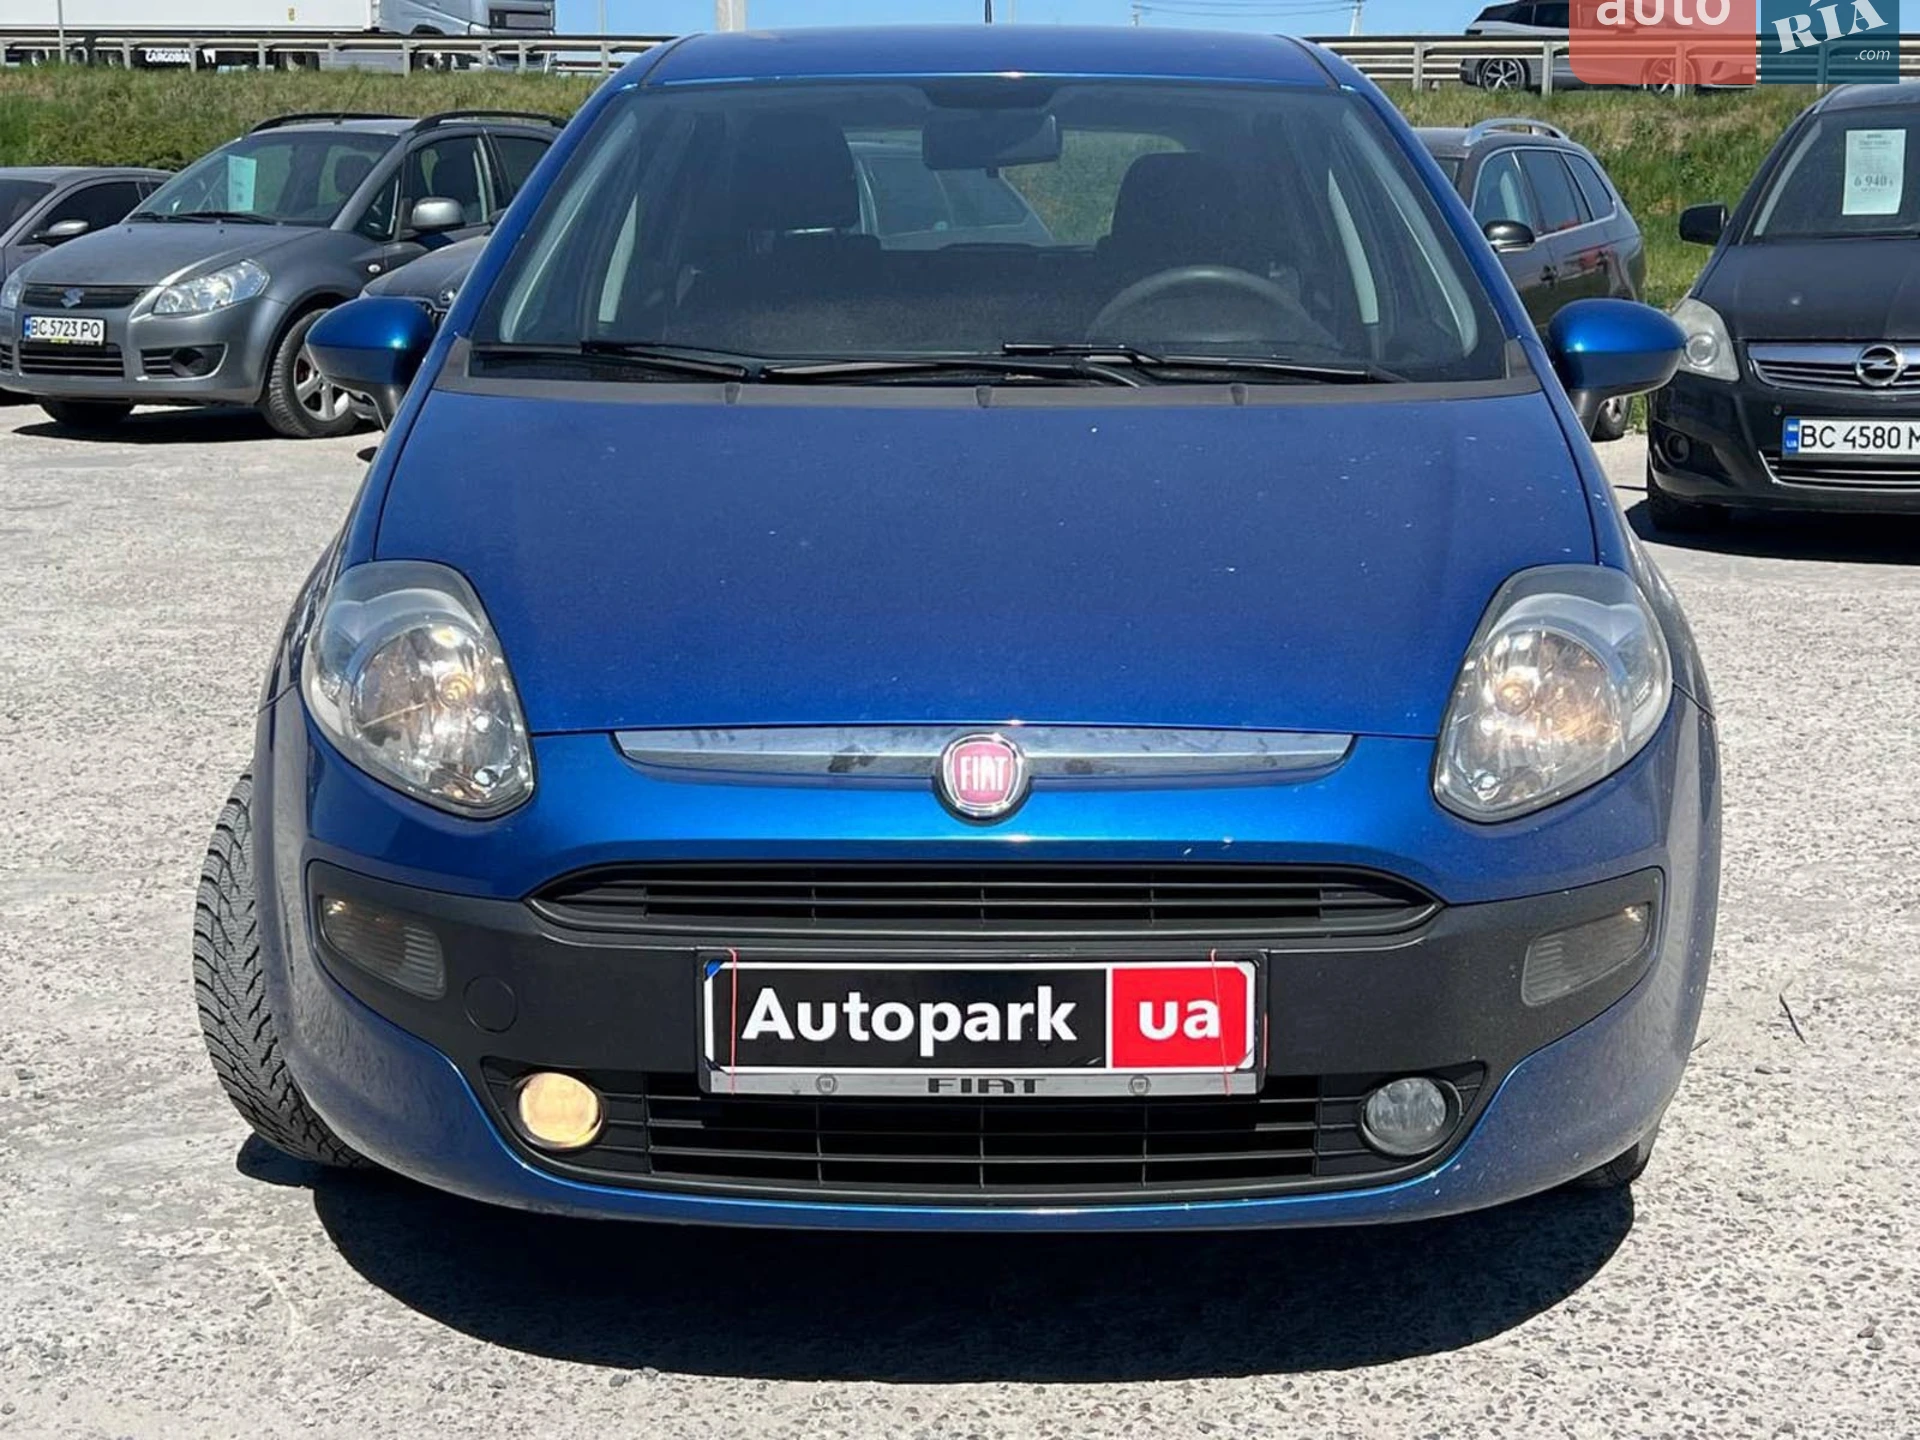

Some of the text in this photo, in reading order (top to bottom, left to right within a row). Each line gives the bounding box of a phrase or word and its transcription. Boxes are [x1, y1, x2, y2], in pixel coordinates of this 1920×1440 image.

[31, 319, 101, 338] BC 5723 PO
[1801, 425, 1836, 448] BC
[1843, 426, 1901, 449] 4580
[960, 756, 1009, 791] FIAT
[741, 985, 1220, 1056] Autopark ua
[928, 1077, 1046, 1094] FIAT
